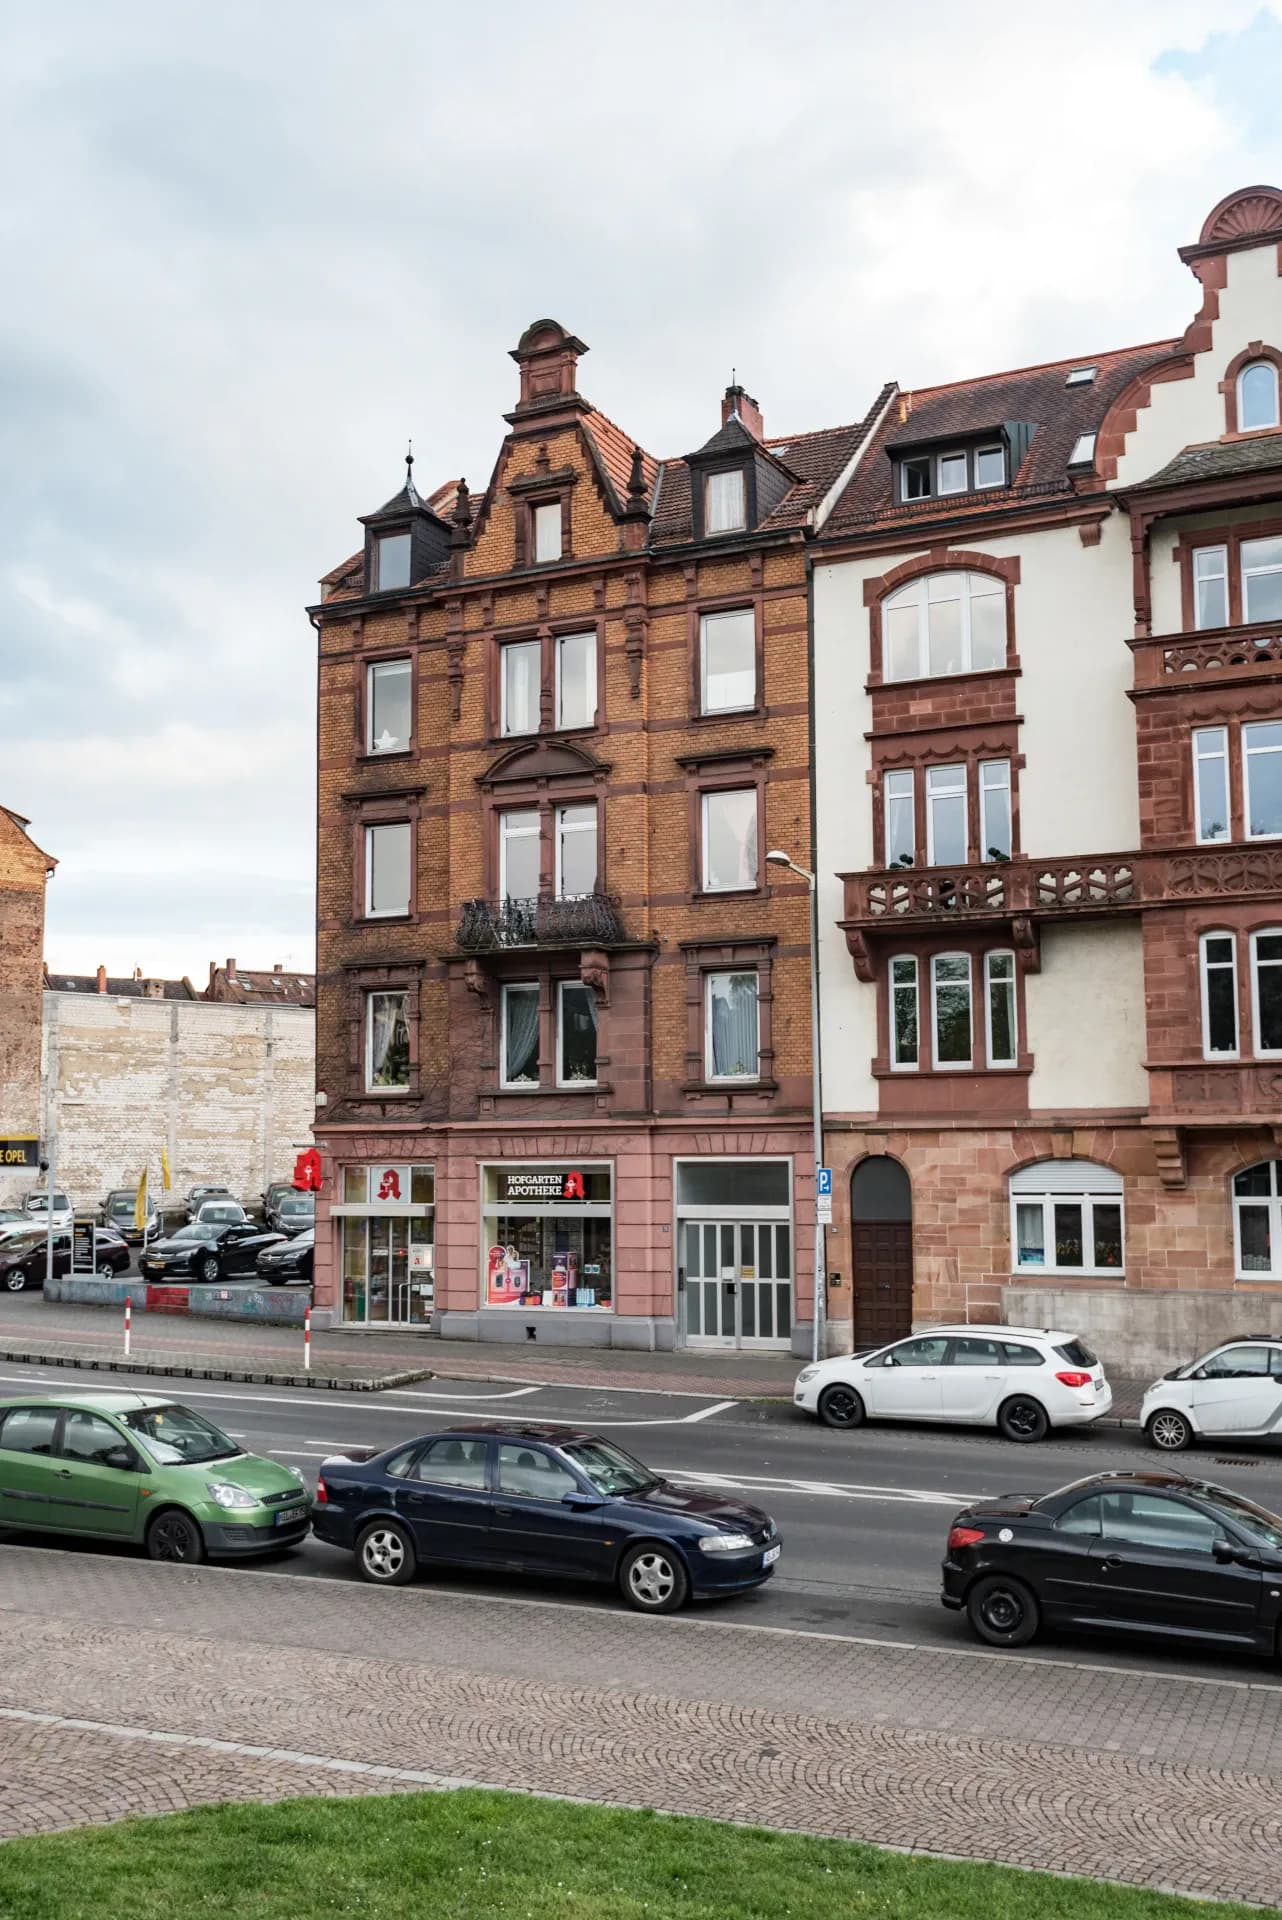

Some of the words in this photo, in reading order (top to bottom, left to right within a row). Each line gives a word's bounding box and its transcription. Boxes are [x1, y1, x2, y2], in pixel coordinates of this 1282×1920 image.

[5, 1150, 27, 1163] OPEL
[507, 1175, 562, 1184] HOFGARTEN
[820, 1172, 828, 1191] P
[507, 1186, 562, 1195] APOTHEKE
